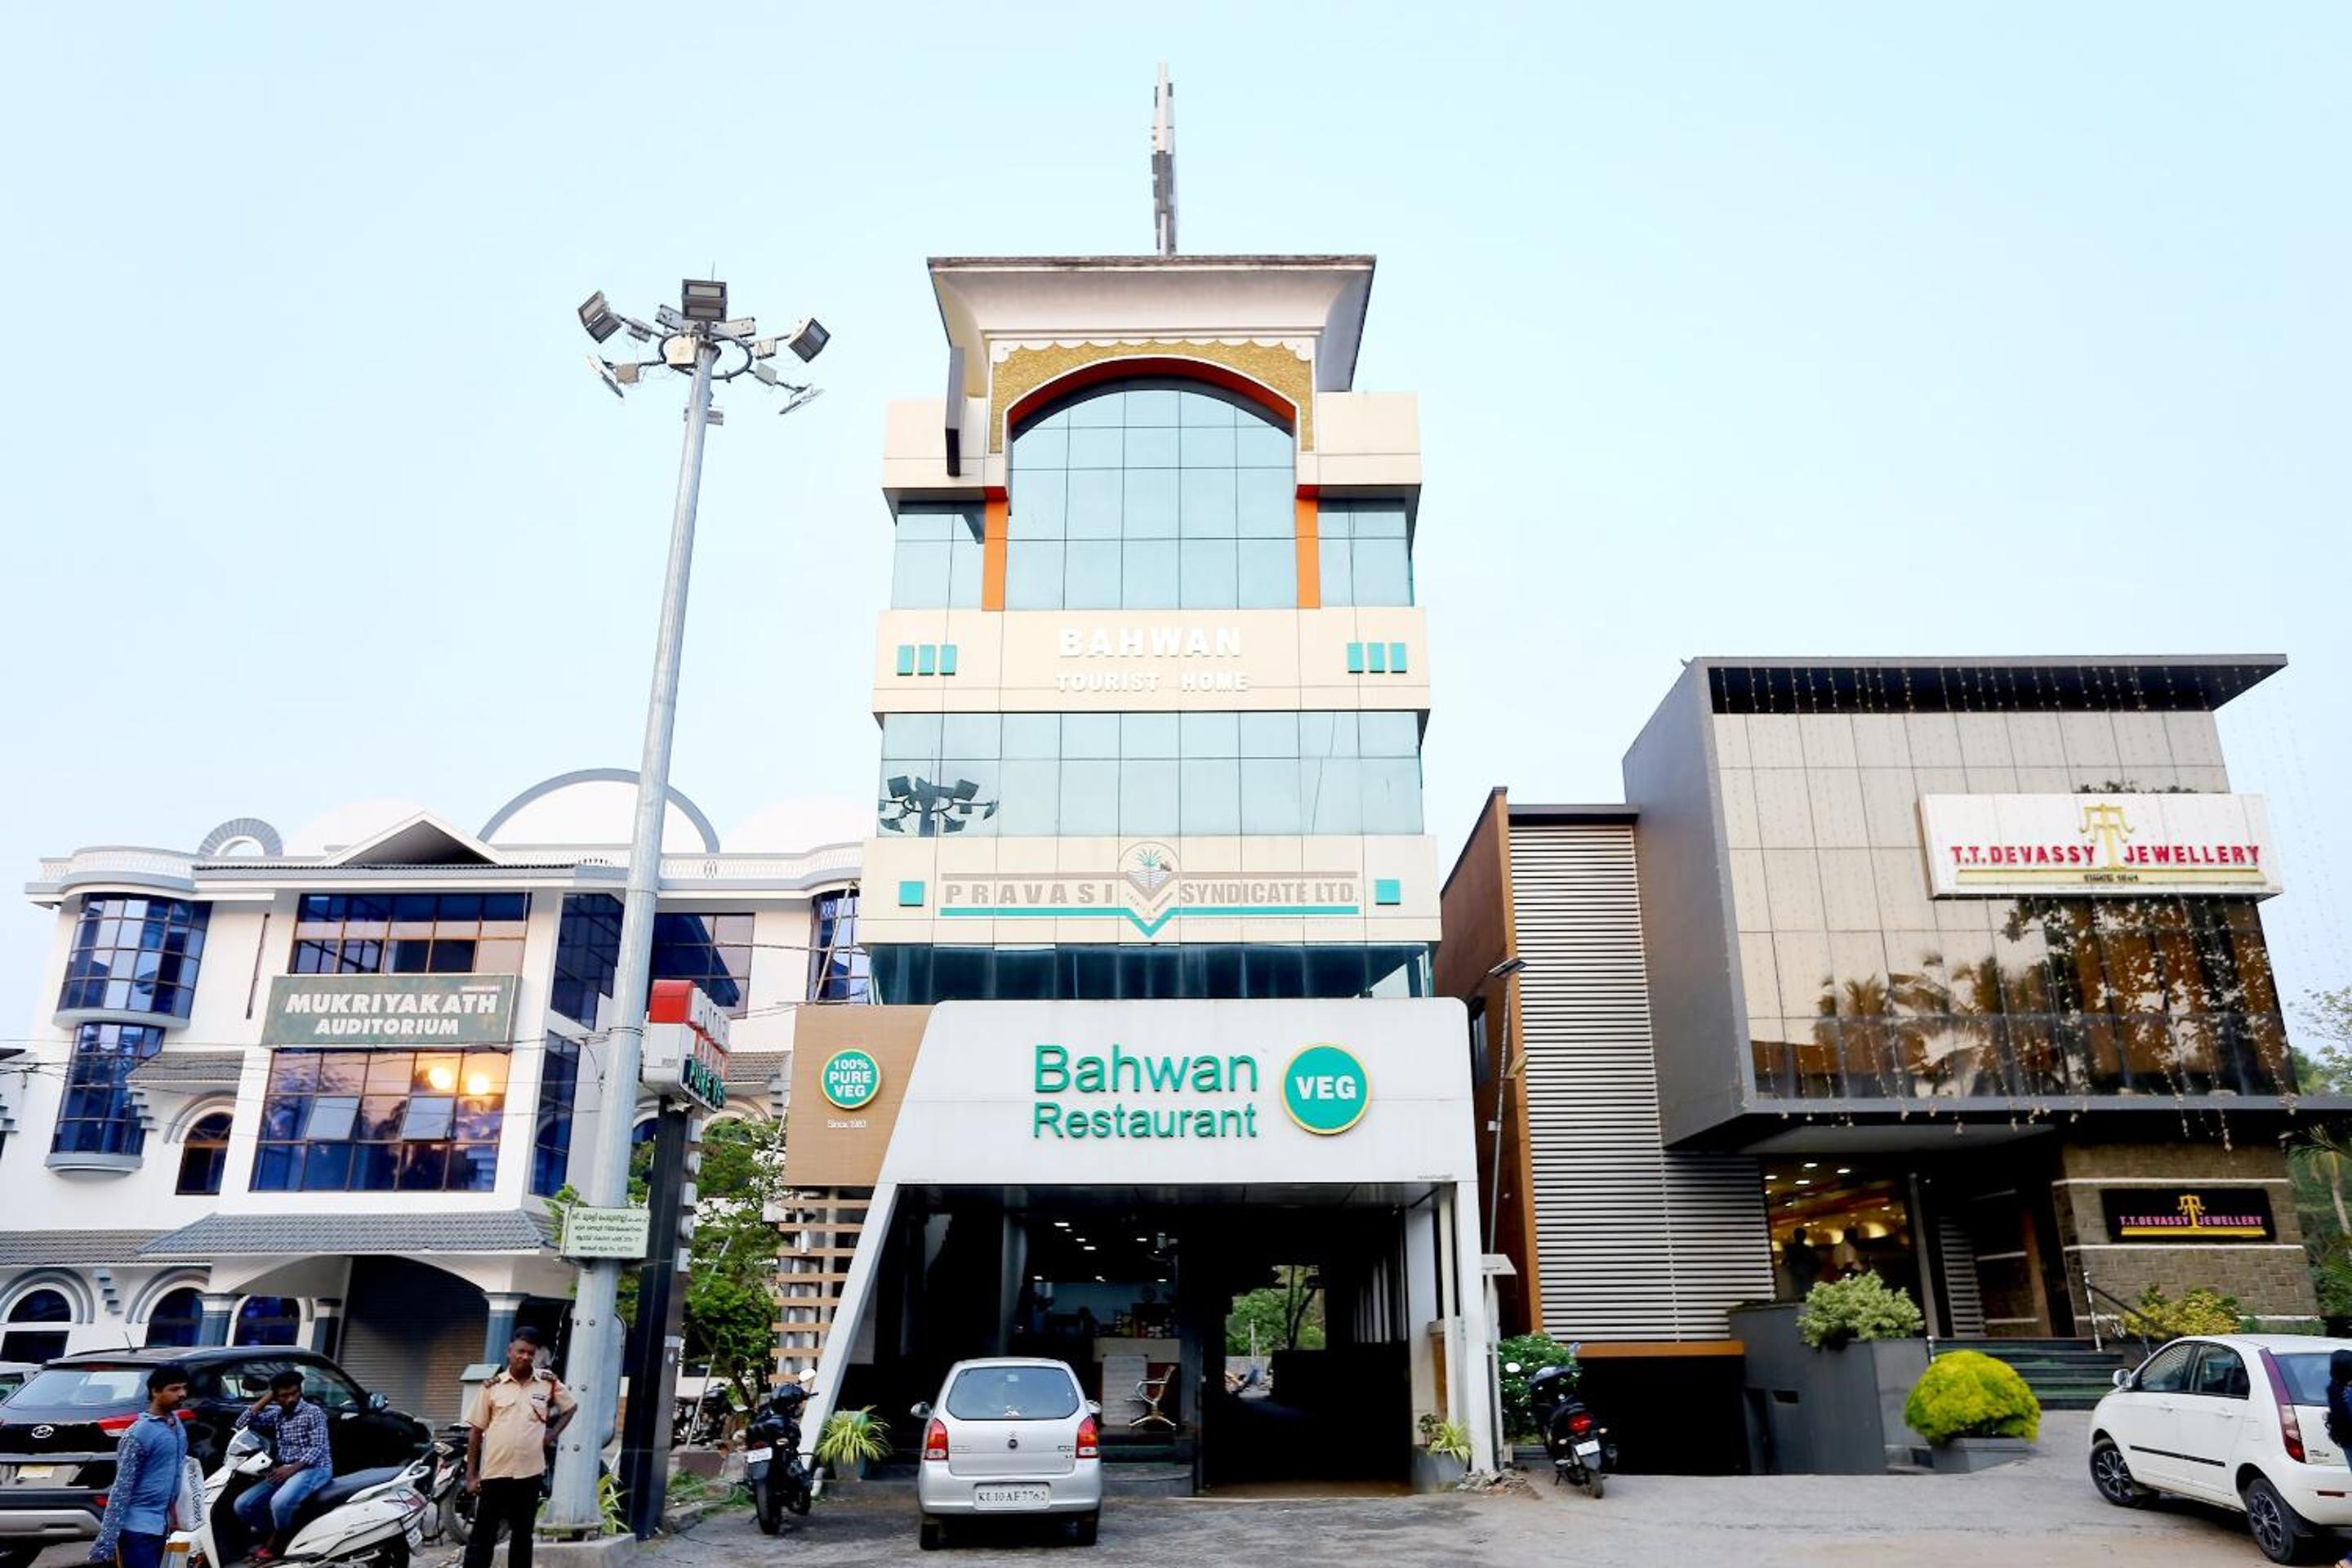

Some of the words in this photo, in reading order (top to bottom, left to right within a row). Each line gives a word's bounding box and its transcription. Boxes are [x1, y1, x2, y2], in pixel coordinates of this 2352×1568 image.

[1058, 627, 1241, 657] BAHWAN
[1056, 672, 1160, 693] TOURIST
[1182, 671, 1250, 693] HOME
[1950, 845, 2095, 866] T.T.DEVASSY
[2123, 845, 2260, 864] JEWELLERY
[945, 884, 1113, 904] PRAVASI
[1181, 882, 1307, 904] SYNDICATE
[1315, 882, 1359, 903] LTD.
[286, 993, 497, 1014] MUKRIYAKATH
[314, 1018, 459, 1036] AUDITORIUM
[834, 1058, 870, 1071] 100%
[1035, 1045, 1258, 1093] Bahwan
[829, 1071, 872, 1084] PURE
[1294, 1076, 1356, 1100] VEG
[834, 1084, 866, 1098] VEG
[1033, 1102, 1258, 1138] Restaurant
[2198, 1215, 2262, 1225] JEWELLERY
